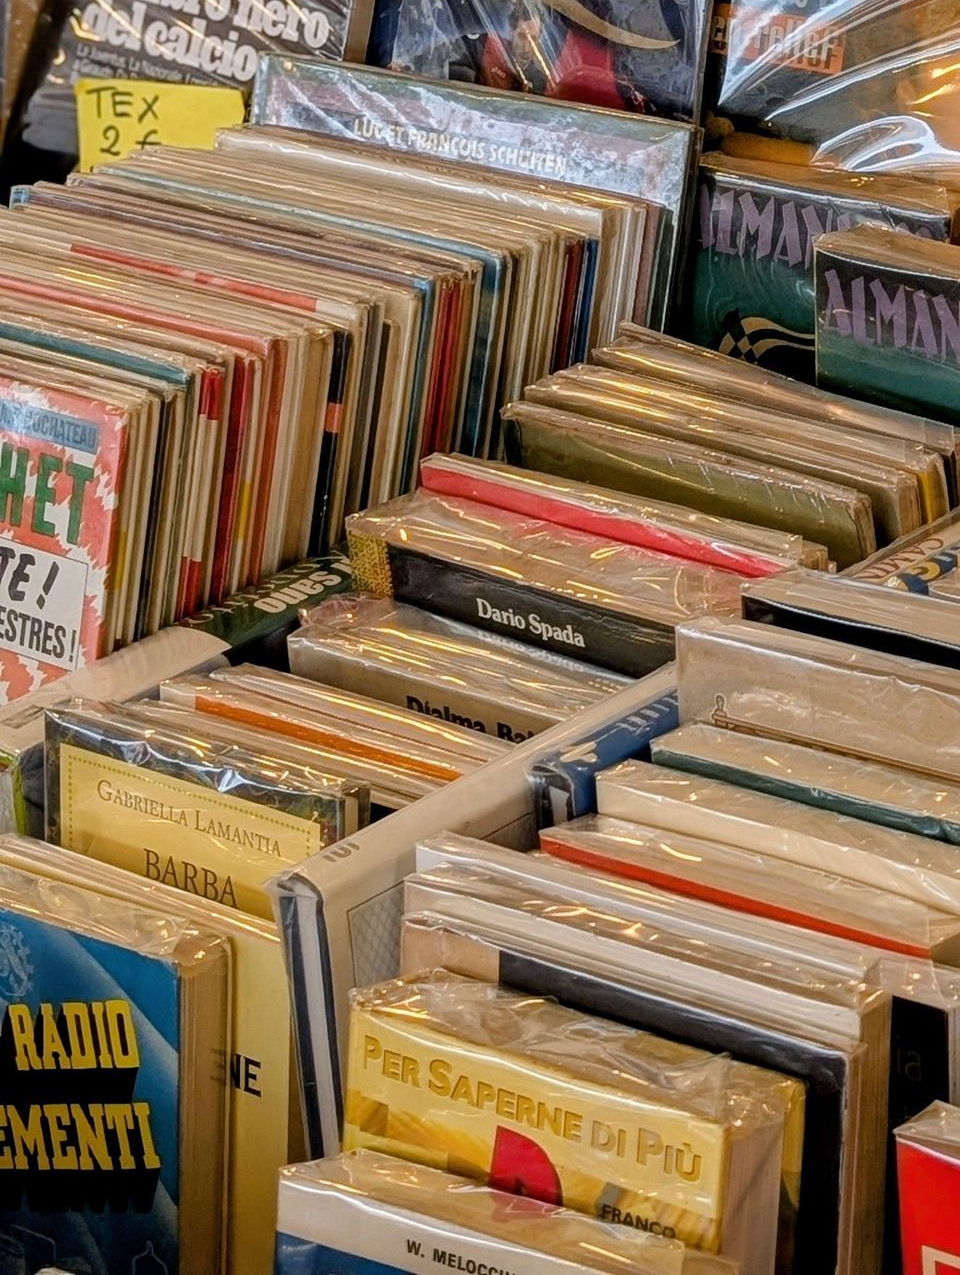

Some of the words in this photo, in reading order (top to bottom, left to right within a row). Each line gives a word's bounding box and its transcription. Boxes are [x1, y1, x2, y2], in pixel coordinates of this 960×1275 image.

[80, 0, 143, 50] del
[145, 9, 258, 82] calcio
[86, 86, 160, 123] TEX
[100, 125, 122, 156] 2
[353, 118, 387, 143] LUC
[388, 123, 408, 146] ET
[408, 127, 486, 164] FRANÇOIS
[475, 597, 527, 632] Dario
[528, 613, 586, 650] Spada
[97, 779, 189, 827] GABRIELLA
[194, 810, 282, 857] LAMANTIA
[143, 847, 239, 909] BARBA
[8, 999, 141, 1071] RADIO
[363, 1032, 421, 1091] PER
[427, 1058, 584, 1143] SAPERNE
[591, 1118, 628, 1157] DI
[637, 1126, 703, 1184] PIÙ
[600, 1203, 677, 1239] FRANCO
[405, 1238, 426, 1259] W.
